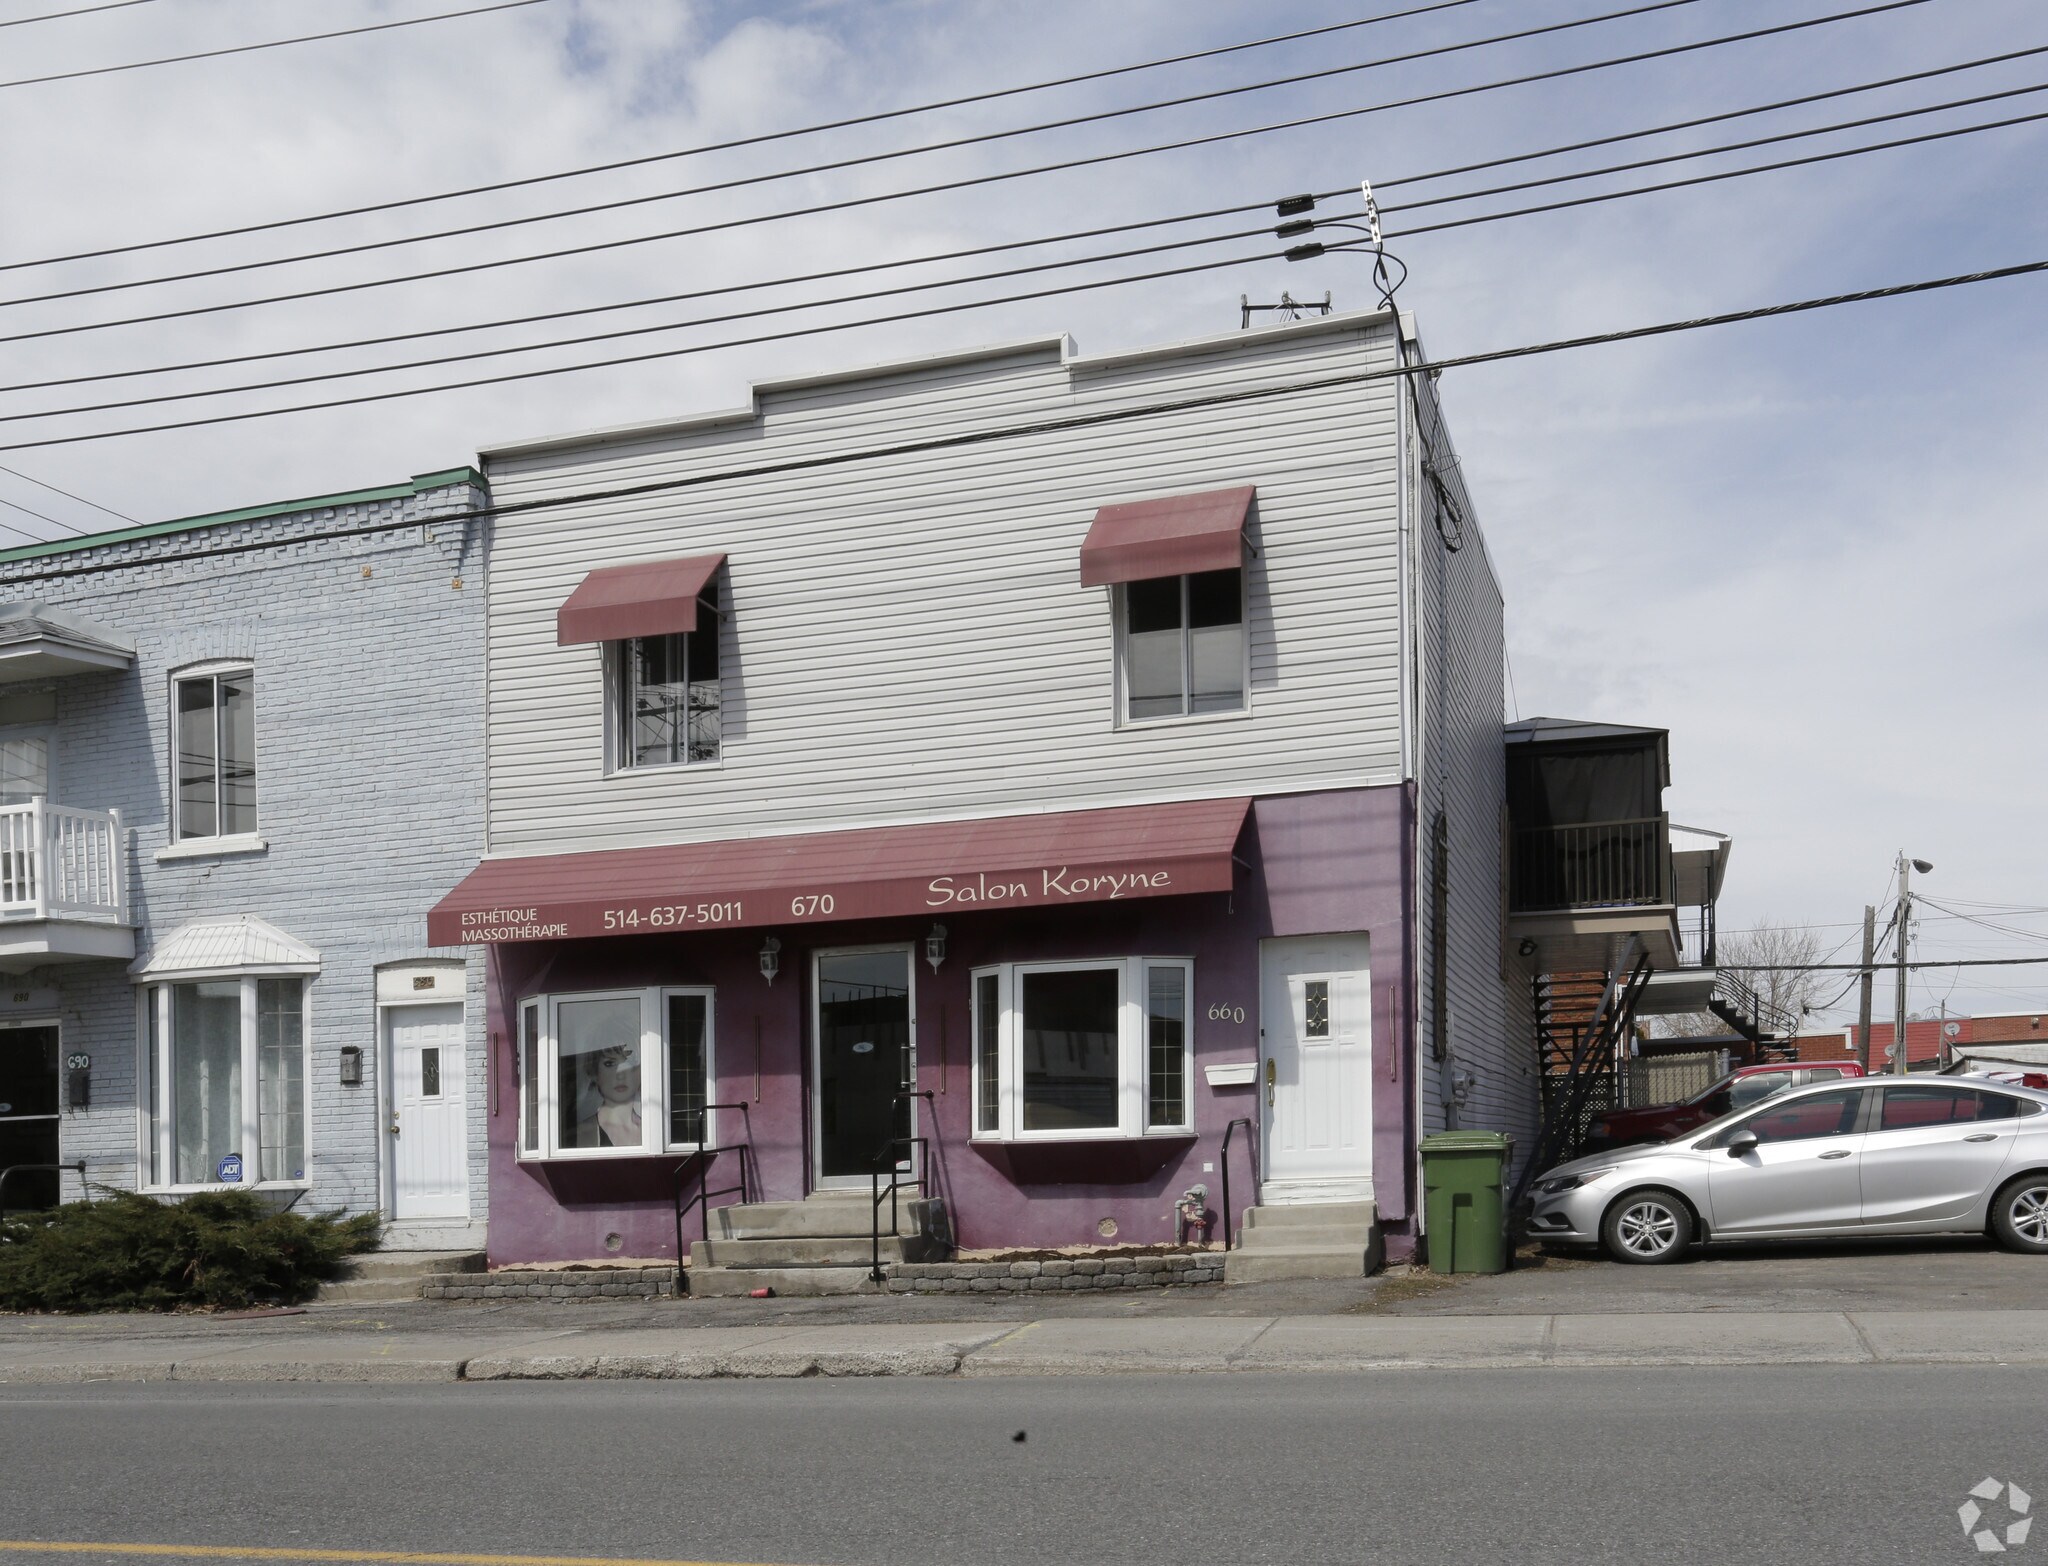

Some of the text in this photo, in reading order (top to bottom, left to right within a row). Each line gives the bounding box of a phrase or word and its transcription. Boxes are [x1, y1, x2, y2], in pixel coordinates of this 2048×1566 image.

[925, 866, 1171, 906] Salon Koryne
[461, 907, 538, 925] ESTHÉTIQUE
[604, 901, 742, 929] 514-637-5011
[791, 894, 835, 917] 670
[462, 922, 568, 942] MASSOTHÉRAPIE
[1208, 1002, 1245, 1024] 660
[67, 1055, 89, 1069] 690
[222, 1164, 239, 1175] ADT
